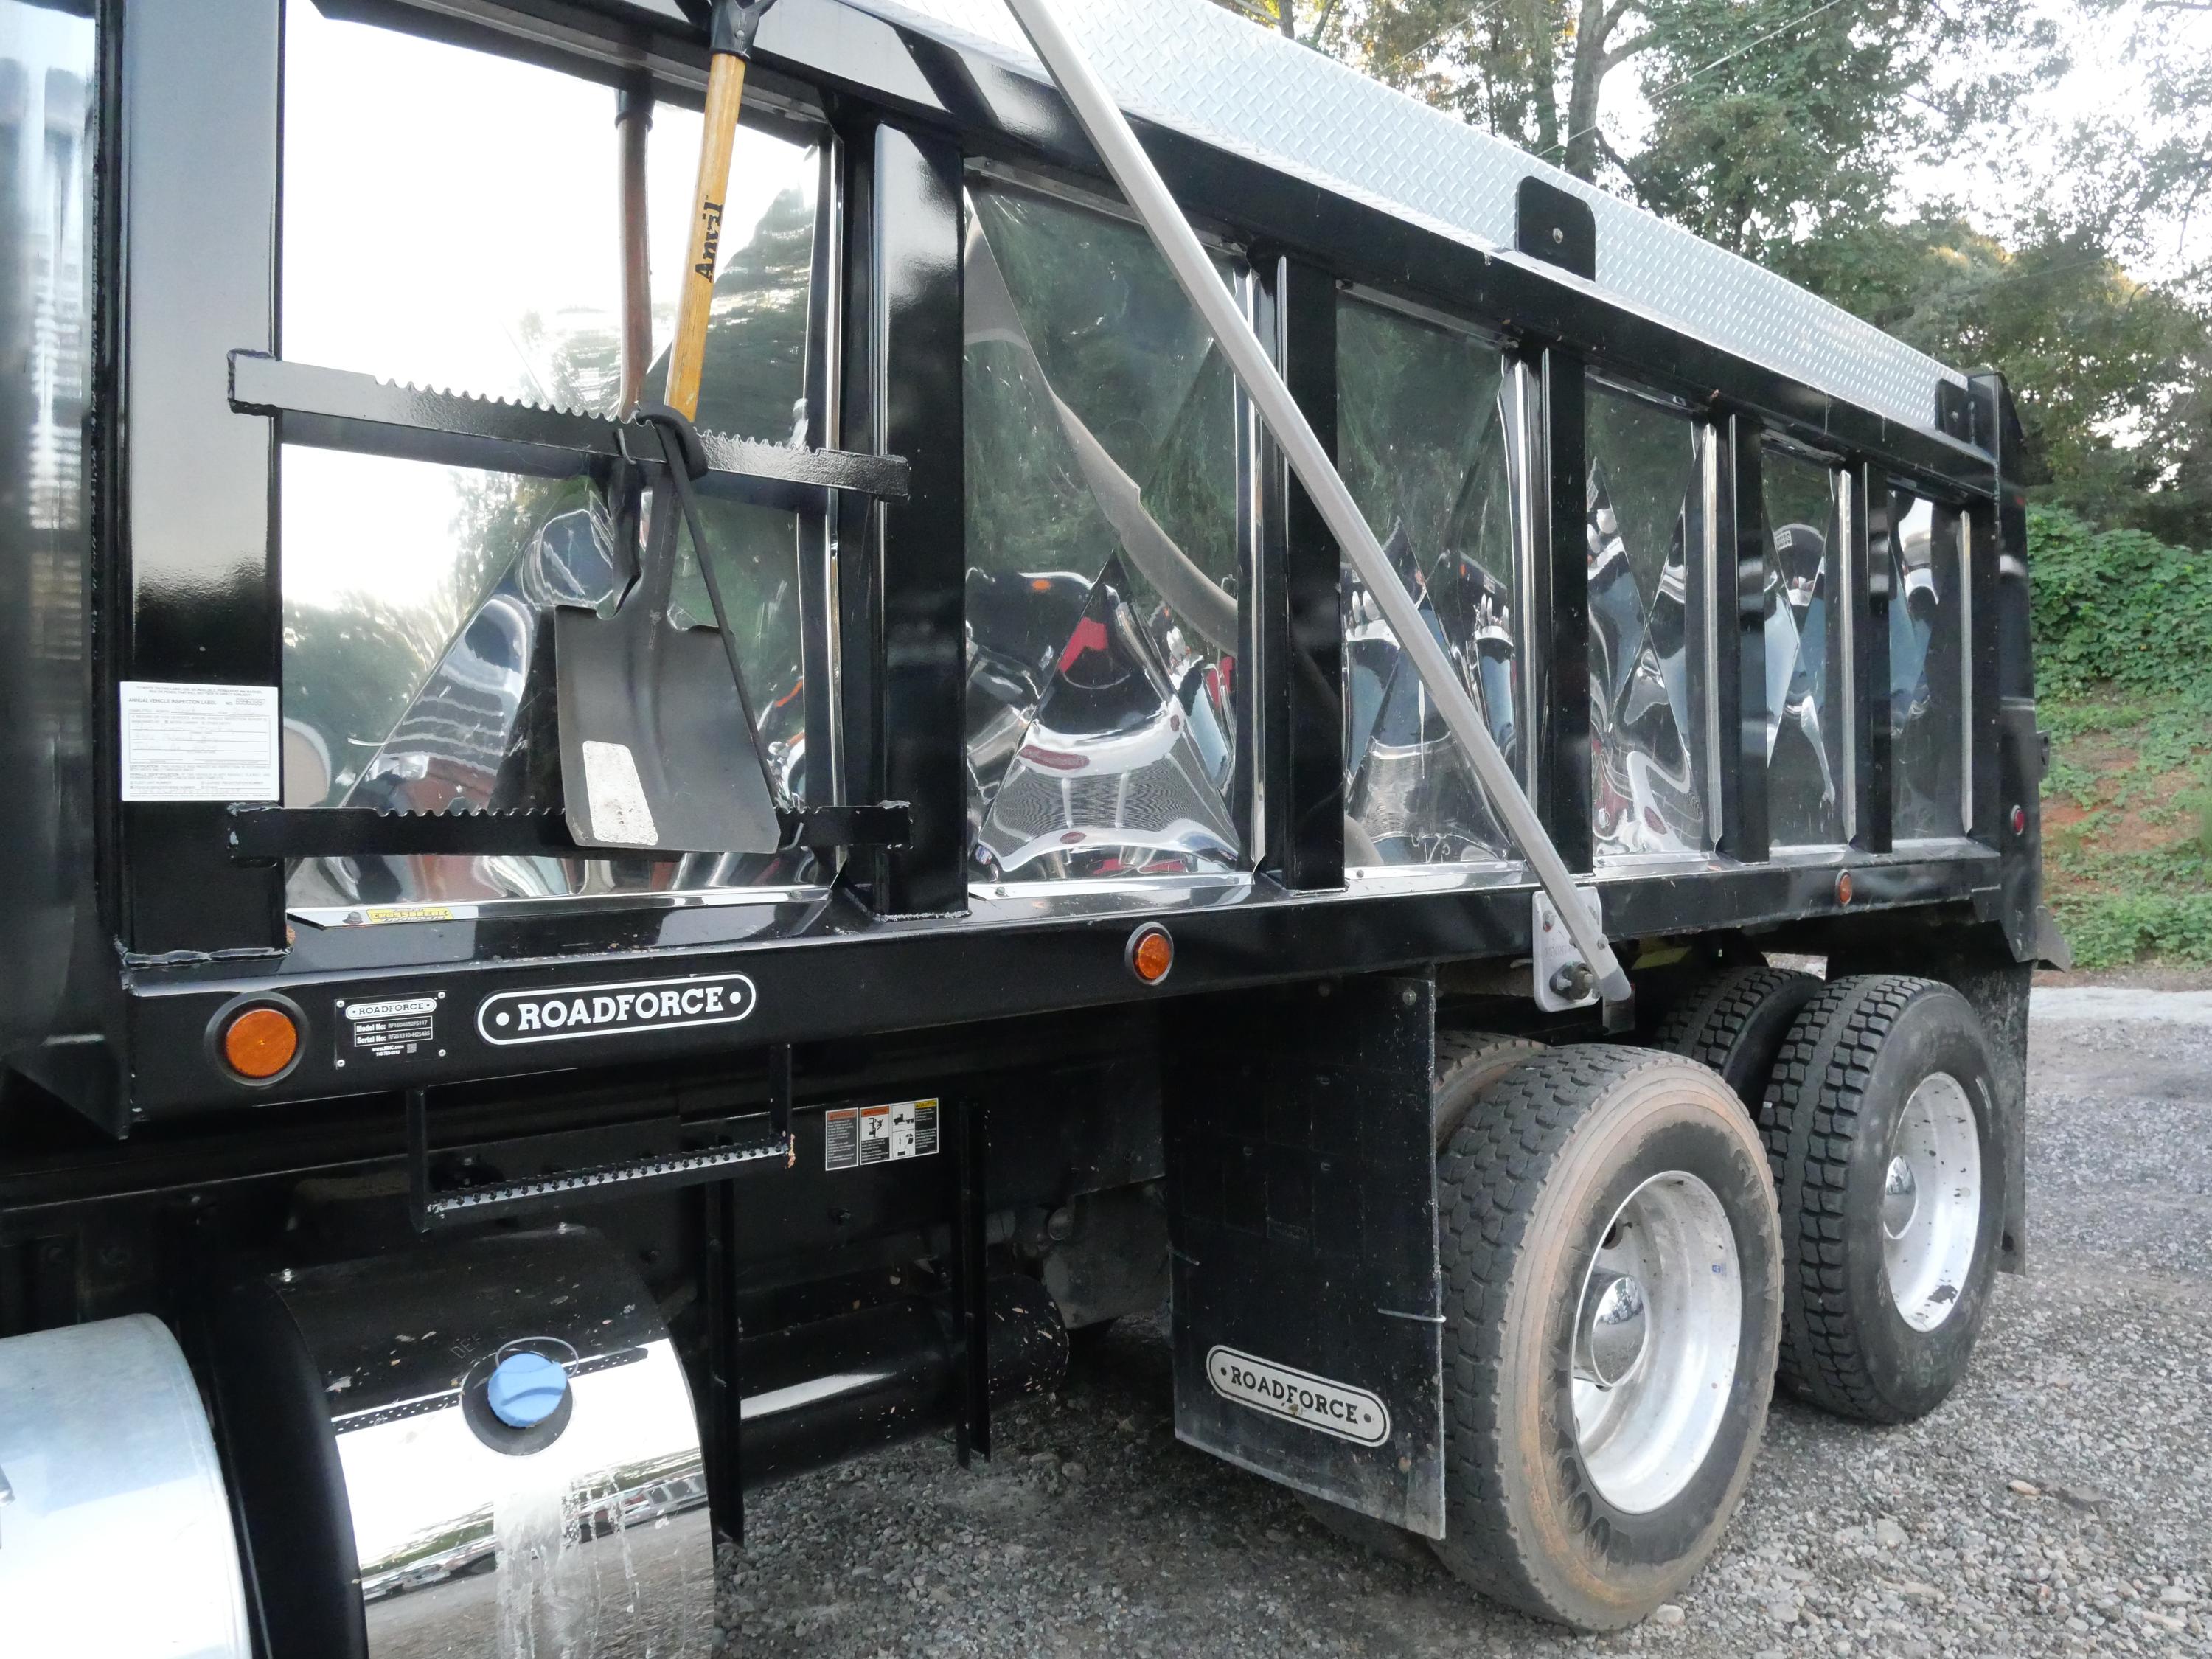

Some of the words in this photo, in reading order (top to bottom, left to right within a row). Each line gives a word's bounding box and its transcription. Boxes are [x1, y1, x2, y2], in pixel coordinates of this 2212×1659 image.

[695, 201, 723, 284] Anvil
[358, 1003, 424, 1015] ROADFORCE
[518, 987, 724, 1031] ROADFORCE
[356, 1024, 375, 1032] Model
[357, 1036, 375, 1044] Serial
[1231, 1366, 1358, 1425] ROADFORCE
